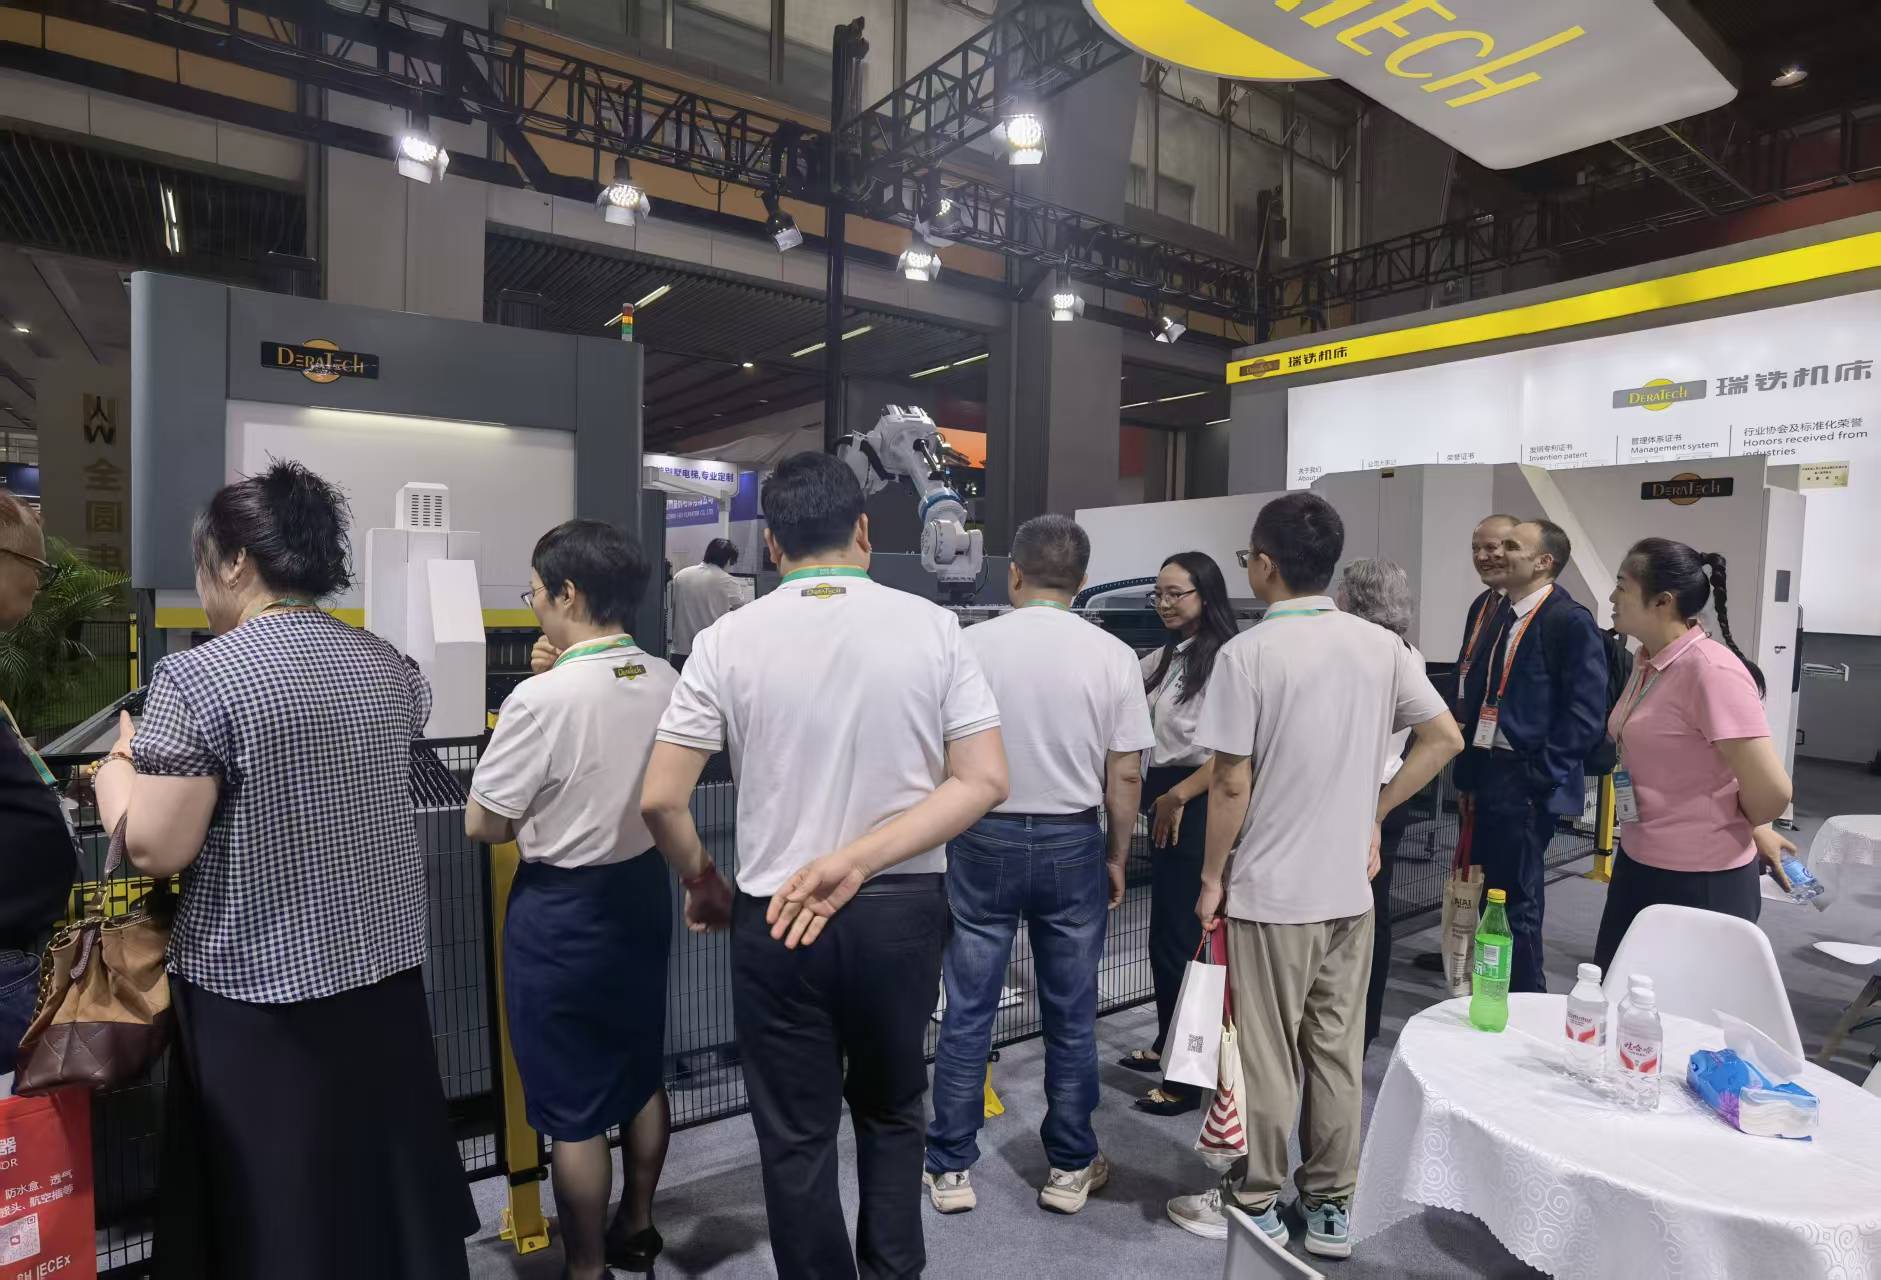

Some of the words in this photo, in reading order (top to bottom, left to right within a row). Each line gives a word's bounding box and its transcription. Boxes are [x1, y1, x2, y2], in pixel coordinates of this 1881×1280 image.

[1288, 347, 1348, 367] 瑞铁机床
[1715, 359, 1873, 397] 瑞铁机床
[1744, 417, 1863, 436] 行业协会及标准化荣誉
[1631, 434, 1682, 446] 管理体系证书
[1743, 438, 1783, 447] Honors
[1785, 432, 1835, 444] received
[1838, 430, 1868, 440] from
[1528, 453, 1563, 462] Invention
[1563, 451, 1588, 460] patent
[1630, 443, 1686, 455] Management
[1687, 441, 1719, 451] system
